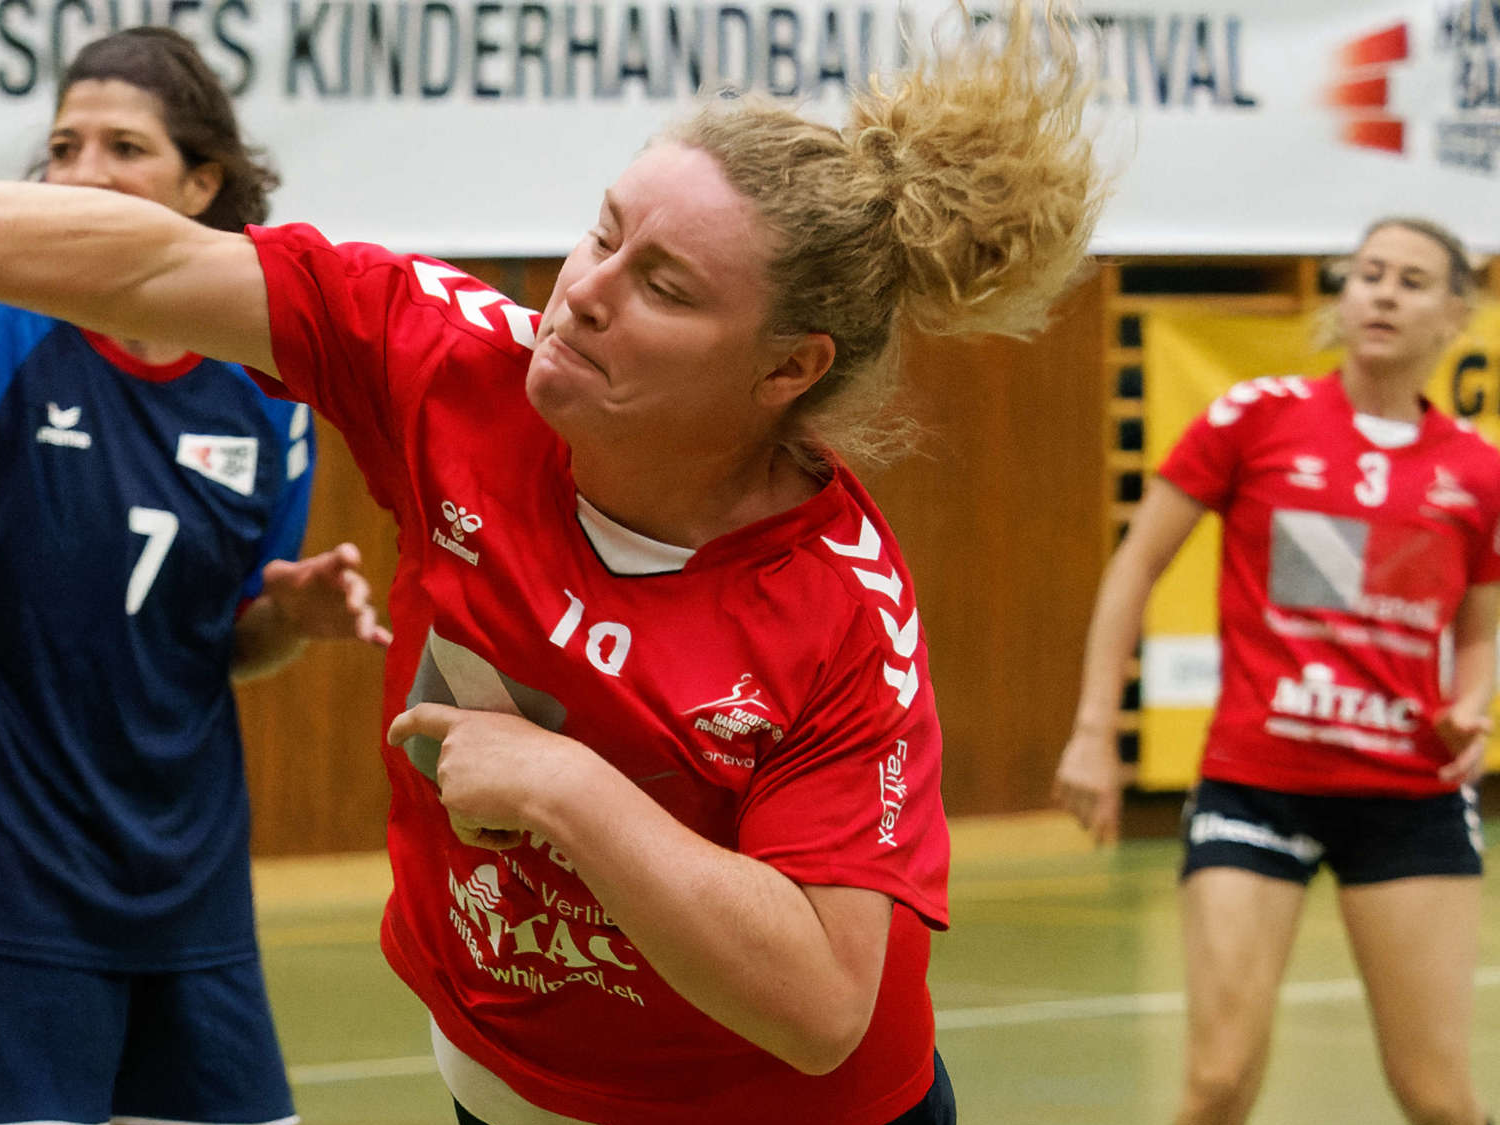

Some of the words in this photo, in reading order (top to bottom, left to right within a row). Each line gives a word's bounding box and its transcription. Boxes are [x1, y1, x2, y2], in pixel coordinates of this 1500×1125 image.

[1356, 452, 1390, 507] 3
[125, 506, 179, 616] 7
[549, 588, 632, 677] 10
